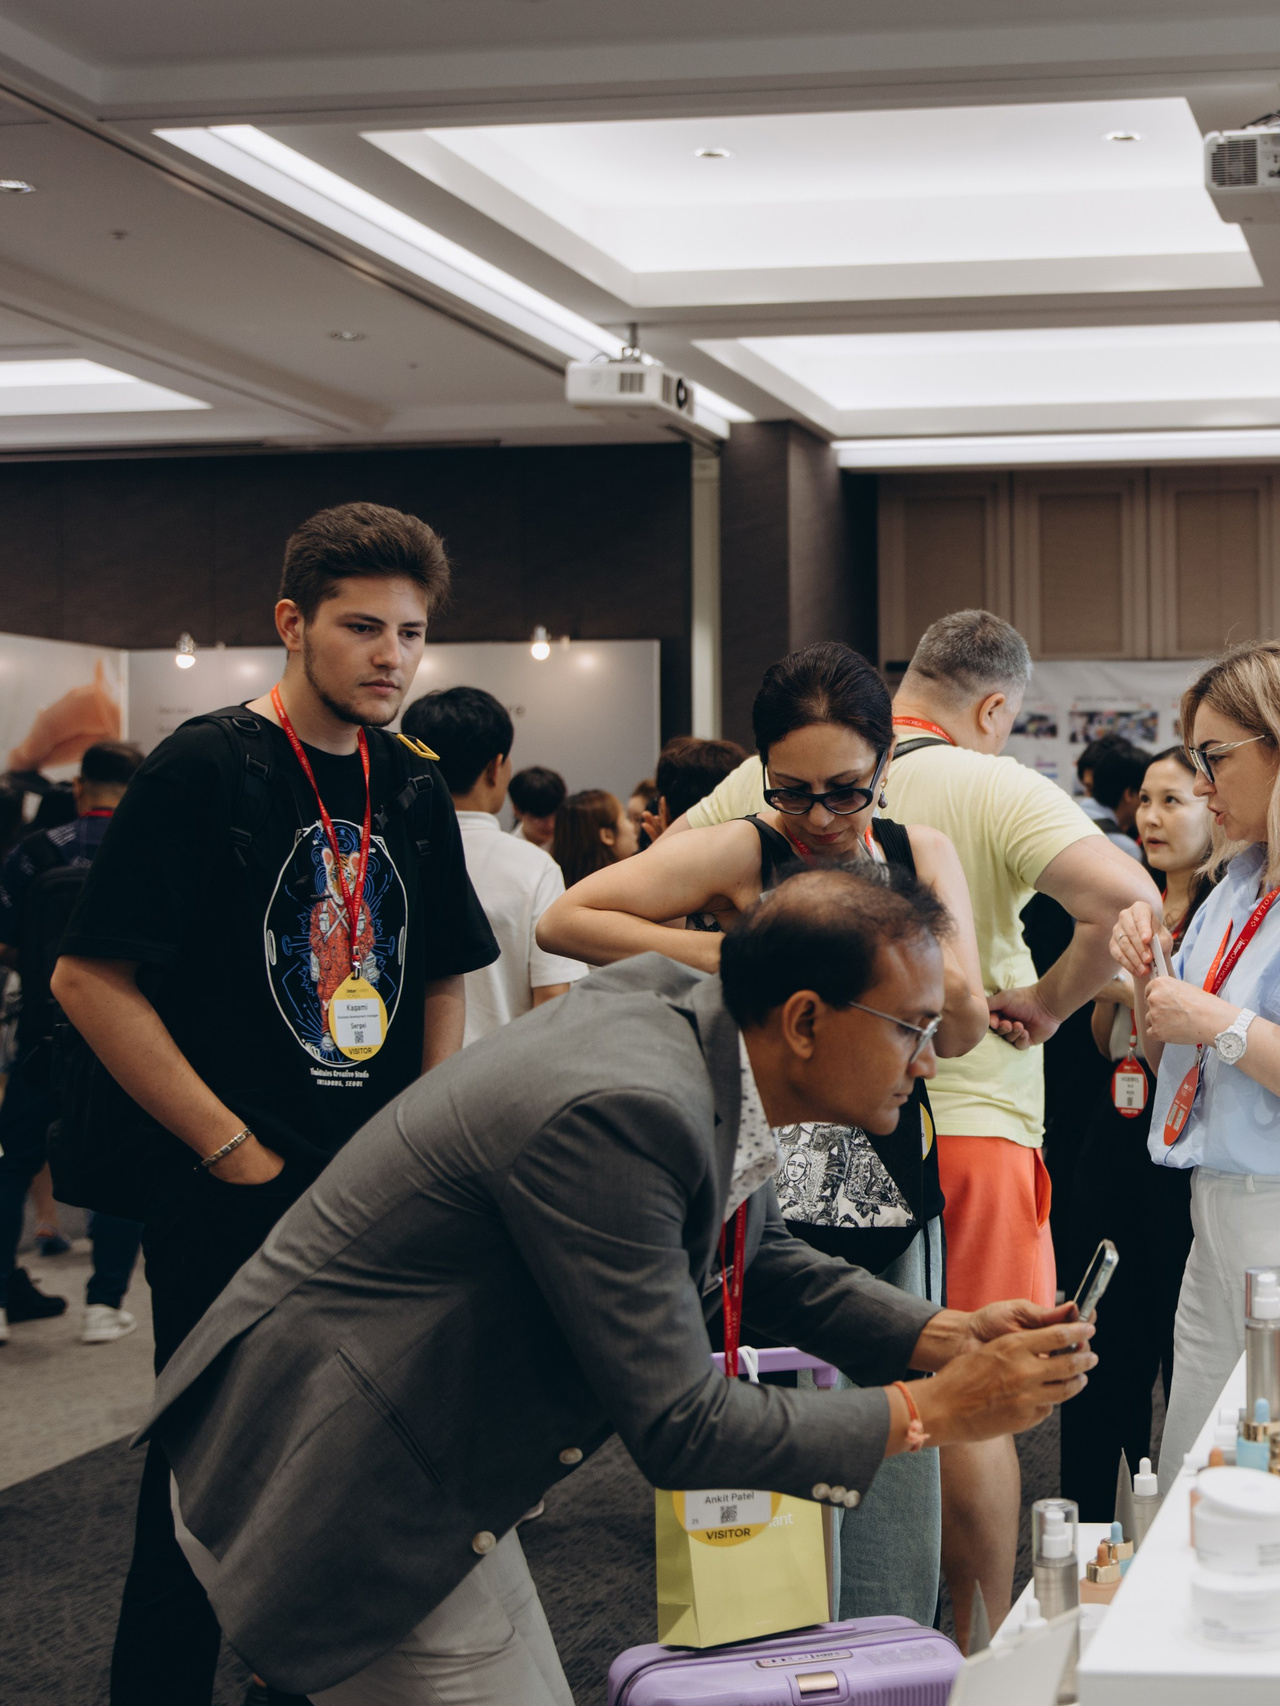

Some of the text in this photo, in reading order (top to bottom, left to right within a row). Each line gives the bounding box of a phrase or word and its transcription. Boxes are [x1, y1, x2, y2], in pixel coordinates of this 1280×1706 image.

[346, 1003, 368, 1012] Kagami
[348, 1047, 372, 1055] VISITOR
[705, 1491, 755, 1504] Ankit Patel
[706, 1528, 751, 1540] VISITOR
